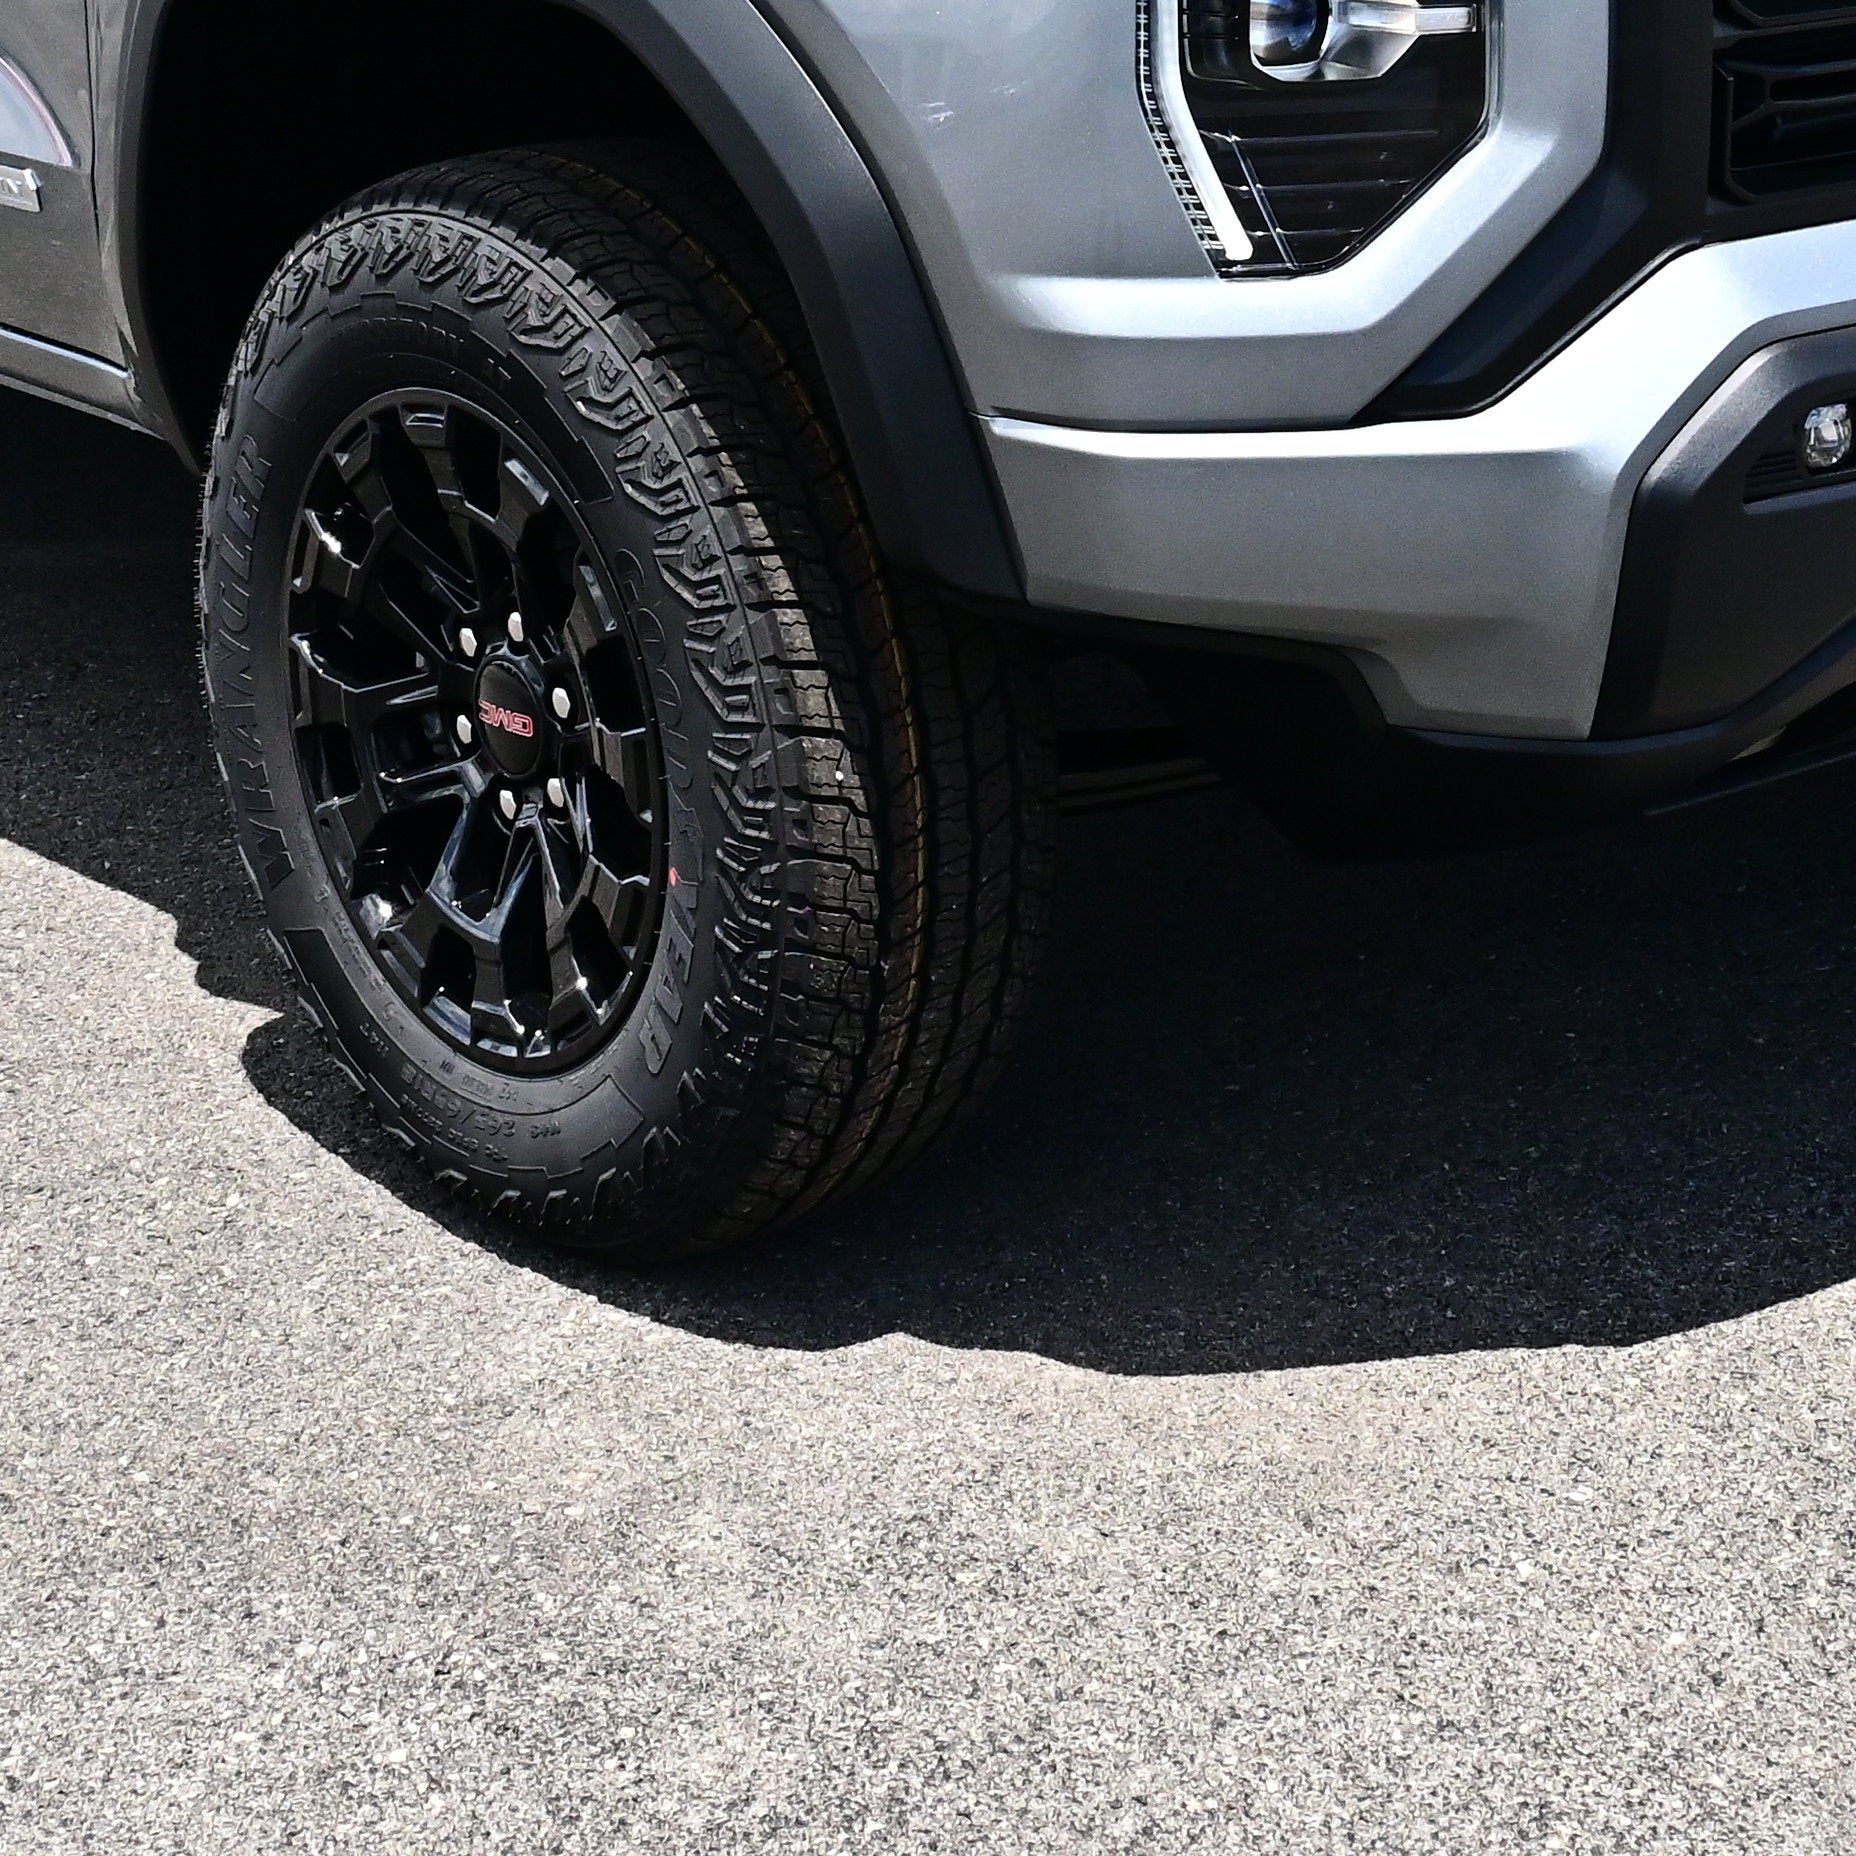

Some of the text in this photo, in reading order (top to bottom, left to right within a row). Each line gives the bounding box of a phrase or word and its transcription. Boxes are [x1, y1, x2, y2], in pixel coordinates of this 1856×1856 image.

[219, 434, 295, 892] WRANGLER
[478, 698, 533, 737] GMC
[617, 548, 704, 1075] GOODYEAR
